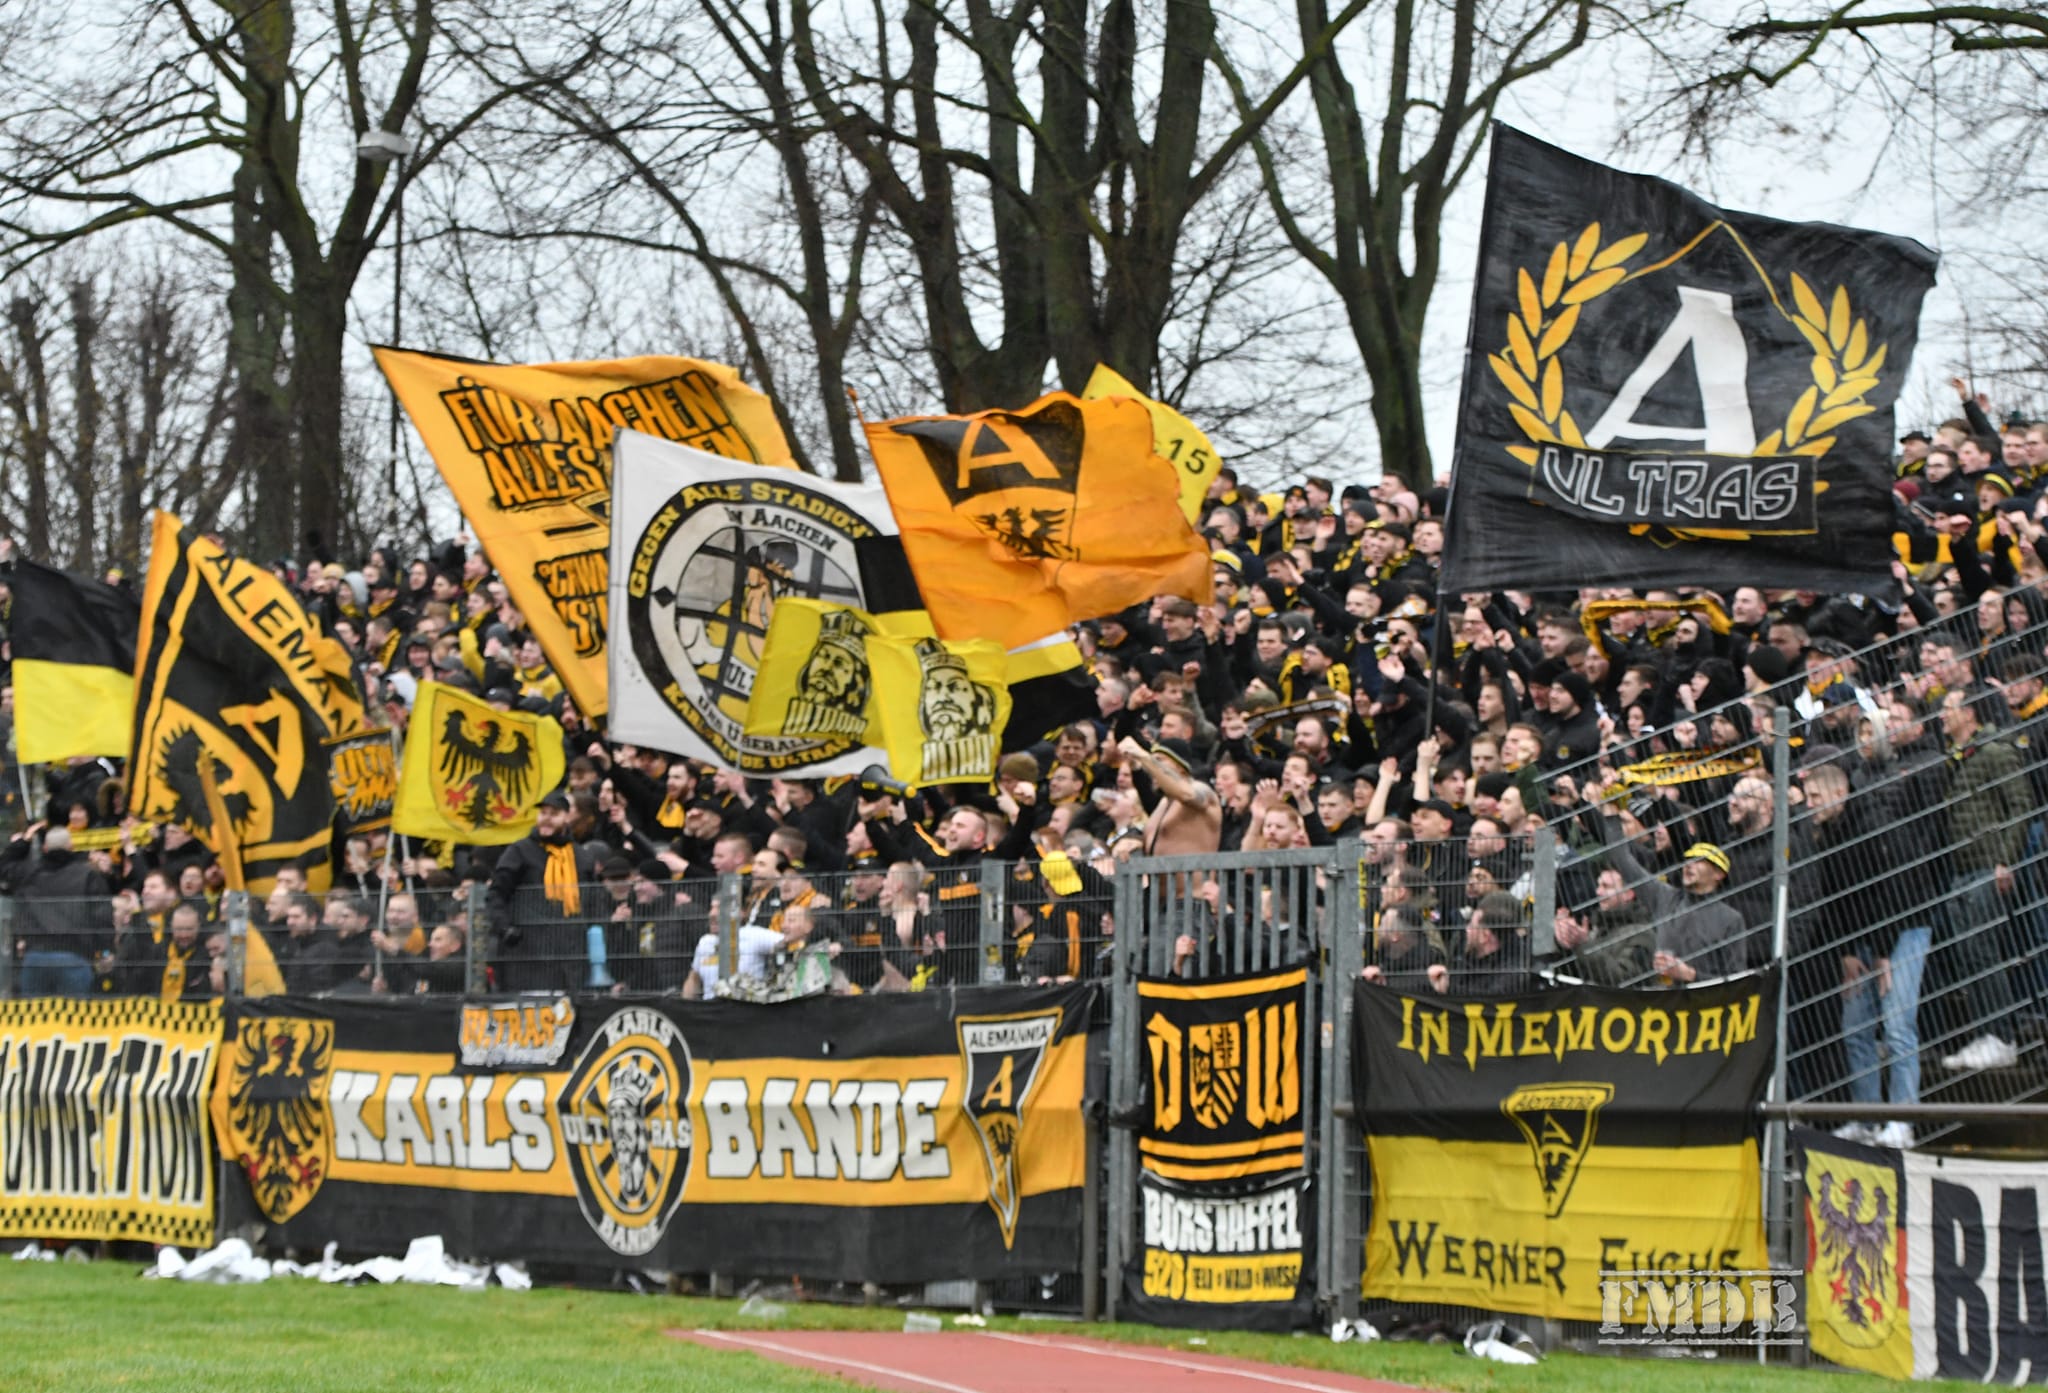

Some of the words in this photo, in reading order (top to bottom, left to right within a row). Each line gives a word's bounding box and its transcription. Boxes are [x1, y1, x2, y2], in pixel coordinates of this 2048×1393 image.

[1585, 285, 1757, 456] A
[482, 435, 609, 510] ALLES
[681, 484, 743, 509] ALLE
[1541, 445, 1800, 521] ULTRAS
[750, 507, 838, 551] AACHEN
[605, 1010, 674, 1047] KARLS
[1397, 997, 1450, 1065] IN
[1463, 993, 1761, 1072] MEMORIAM
[329, 1071, 557, 1172] KARLS
[702, 1078, 951, 1181] BANDE
[1387, 1219, 1567, 1298] WERNER
